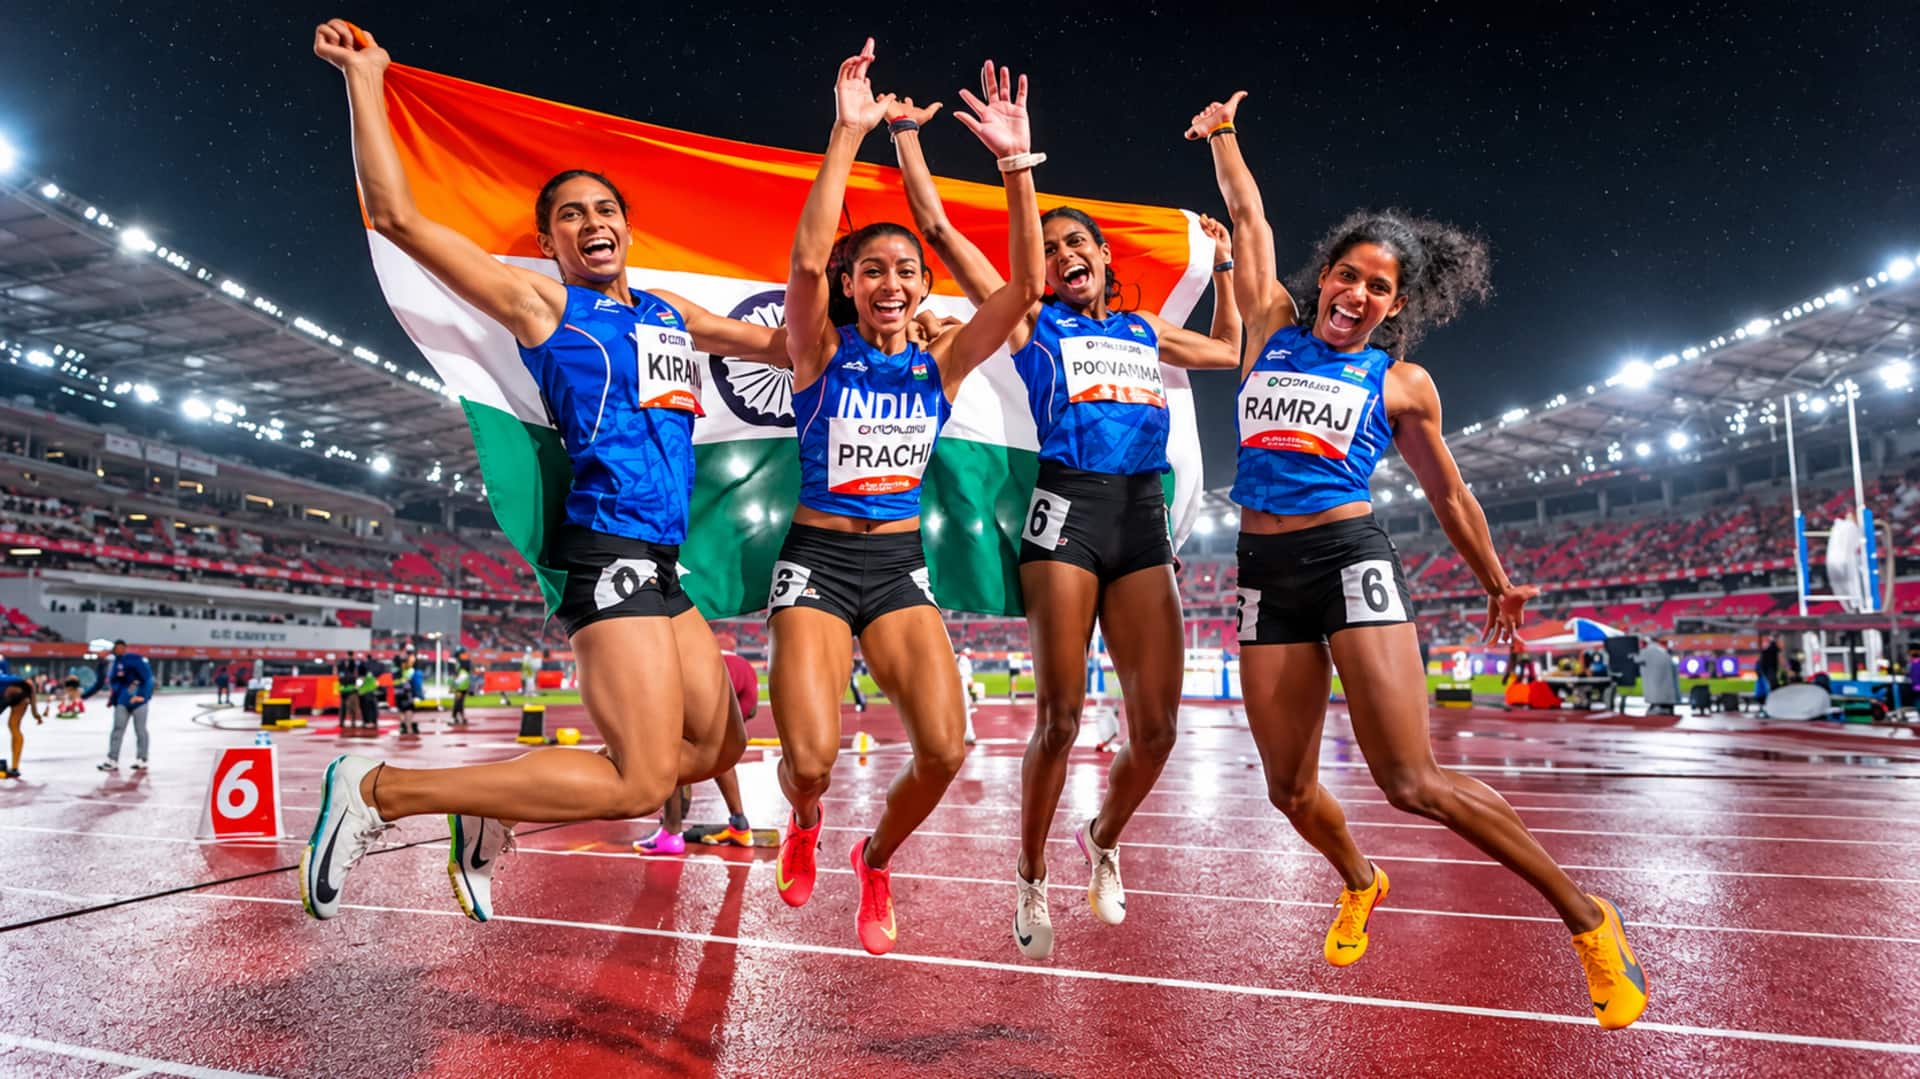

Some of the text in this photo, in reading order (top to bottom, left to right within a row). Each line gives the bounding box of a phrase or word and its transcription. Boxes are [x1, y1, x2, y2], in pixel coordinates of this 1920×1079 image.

[648, 352, 702, 390] KIRAN
[1072, 360, 1162, 383] POOVAMMA
[837, 387, 927, 418] INDIA
[1245, 396, 1352, 431] RAMRAJ
[838, 443, 931, 468] PRACHI
[1030, 498, 1051, 537] 6
[1361, 567, 1389, 613] 6
[216, 760, 259, 819] 6
